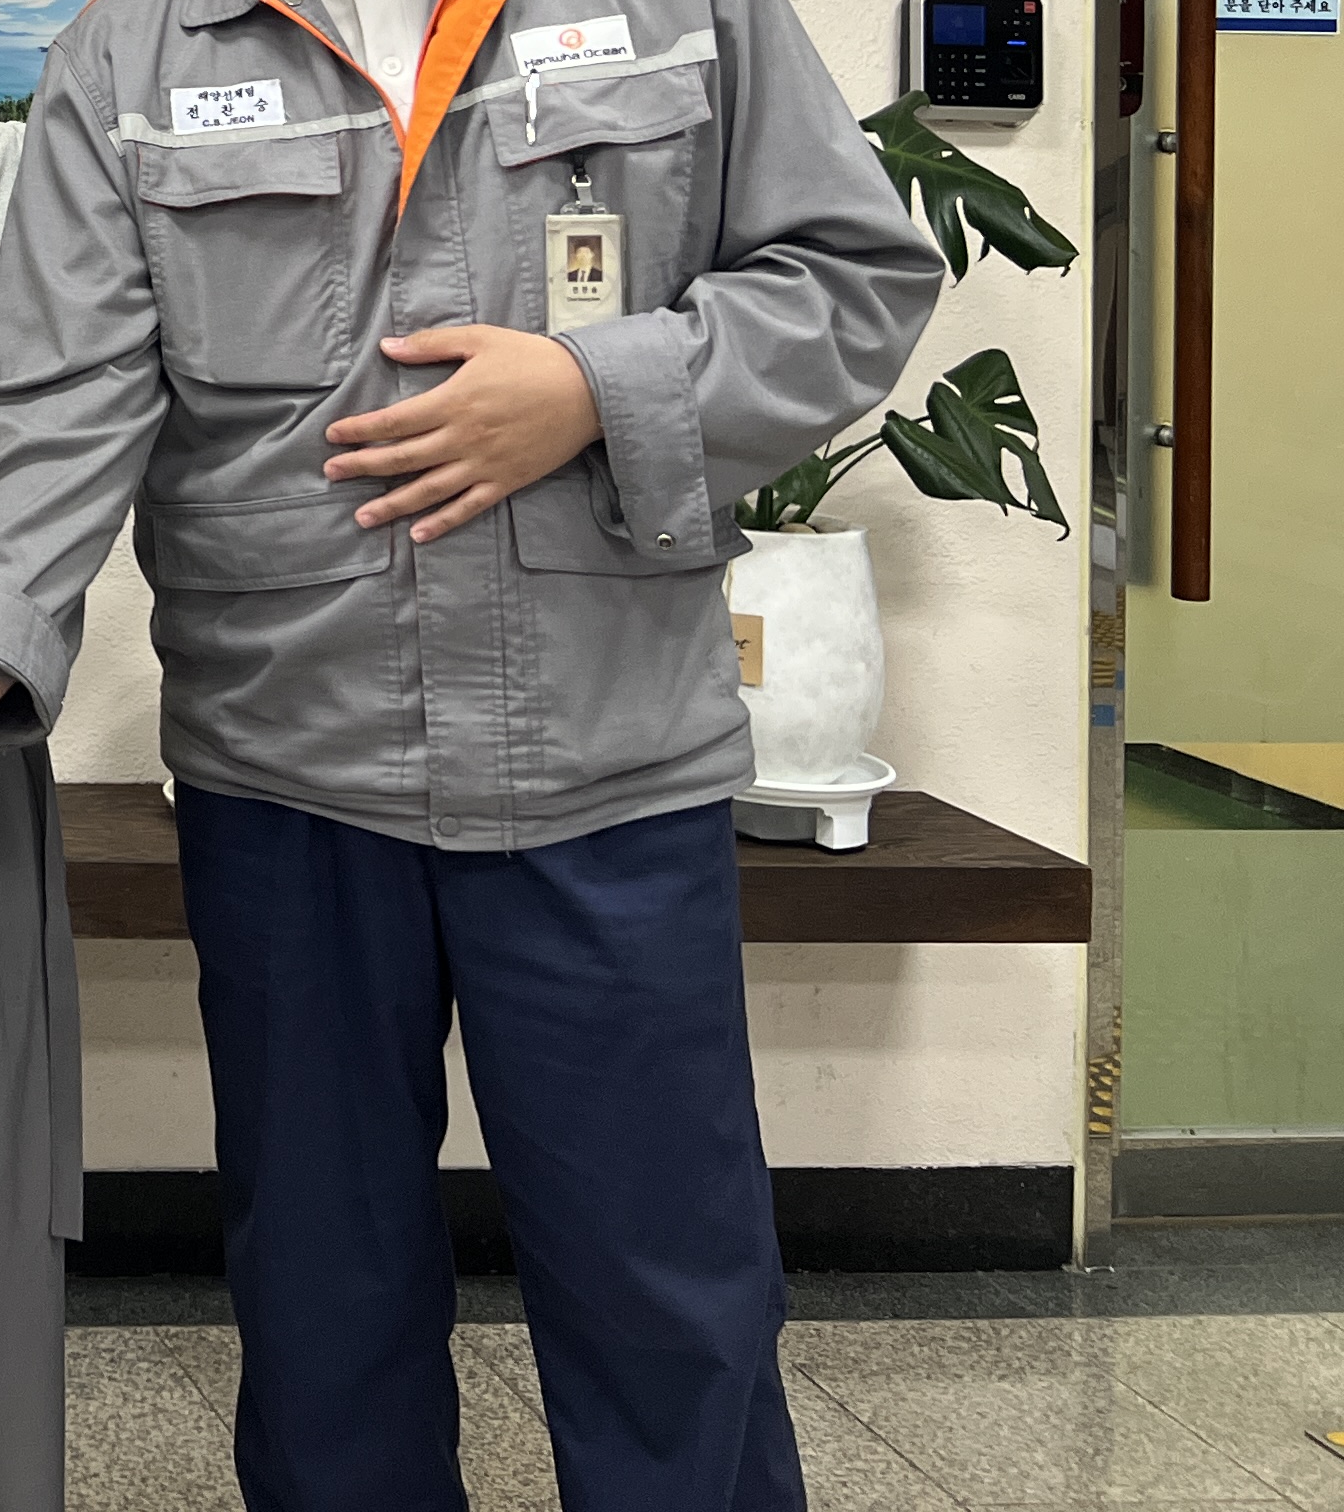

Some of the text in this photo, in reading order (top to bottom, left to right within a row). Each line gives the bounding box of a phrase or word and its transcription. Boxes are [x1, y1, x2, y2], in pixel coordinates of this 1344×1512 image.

[1290, 0, 1332, 14] 주세요
[524, 46, 627, 69] Hanwha Ocean
